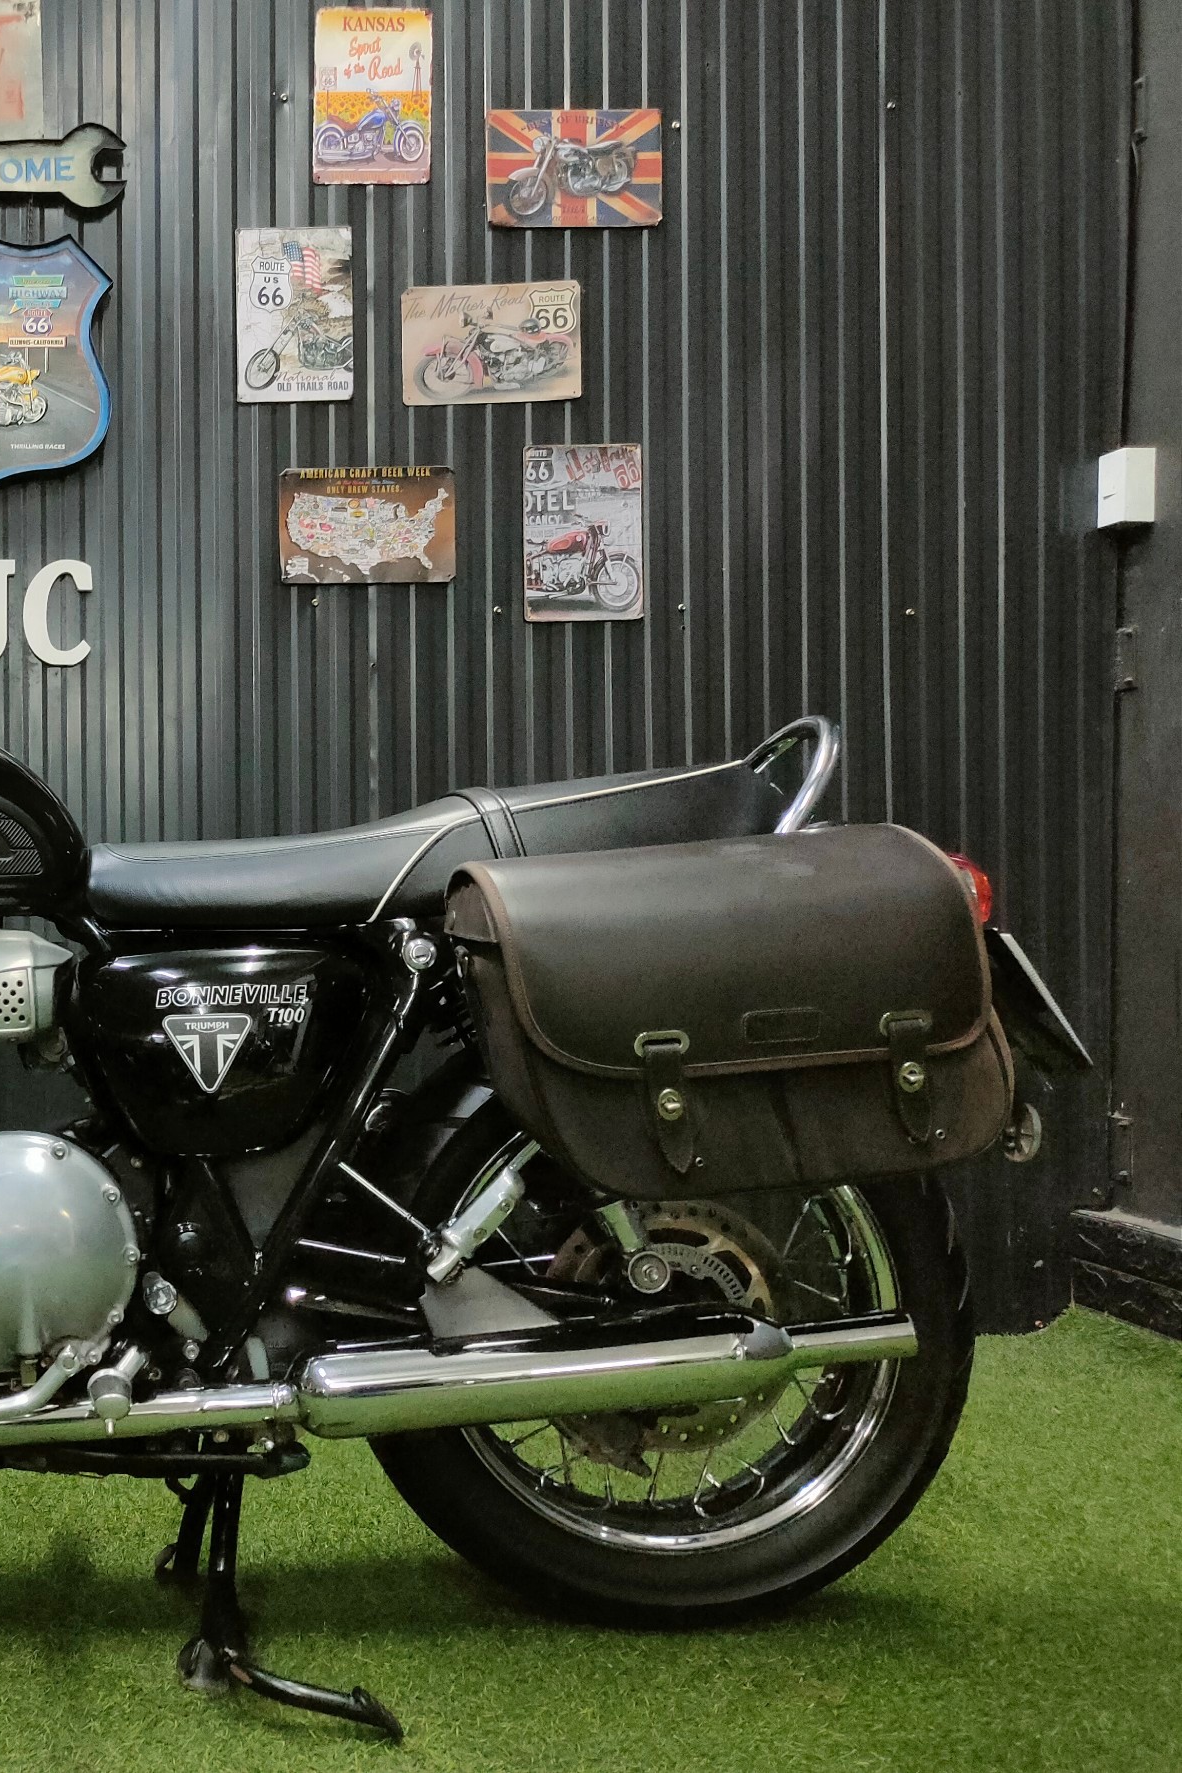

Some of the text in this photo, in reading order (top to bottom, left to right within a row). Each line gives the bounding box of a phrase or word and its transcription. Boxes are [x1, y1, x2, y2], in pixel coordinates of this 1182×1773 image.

[343, 17, 405, 32] KANSAS
[368, 56, 403, 81] Road
[259, 261, 285, 272] ROUTE
[11, 289, 64, 298] HIGHWAY
[257, 286, 284, 306] 66
[538, 295, 566, 303] ROUTE
[405, 286, 529, 322] The Mother Road
[25, 318, 49, 333] 66
[536, 307, 568, 330] 66
[276, 369, 336, 382] National
[277, 381, 348, 392] OLD TRAILS ROAD
[299, 467, 431, 479] AMERICAN CRAFT BEER WEEK
[526, 462, 549, 480] 66
[326, 486, 344, 494] ONLY
[347, 486, 368, 494] BREW
[156, 985, 307, 1008] BONNEVILLE
[267, 1007, 305, 1023] T100
[185, 1022, 229, 1033] TRIUMPH
